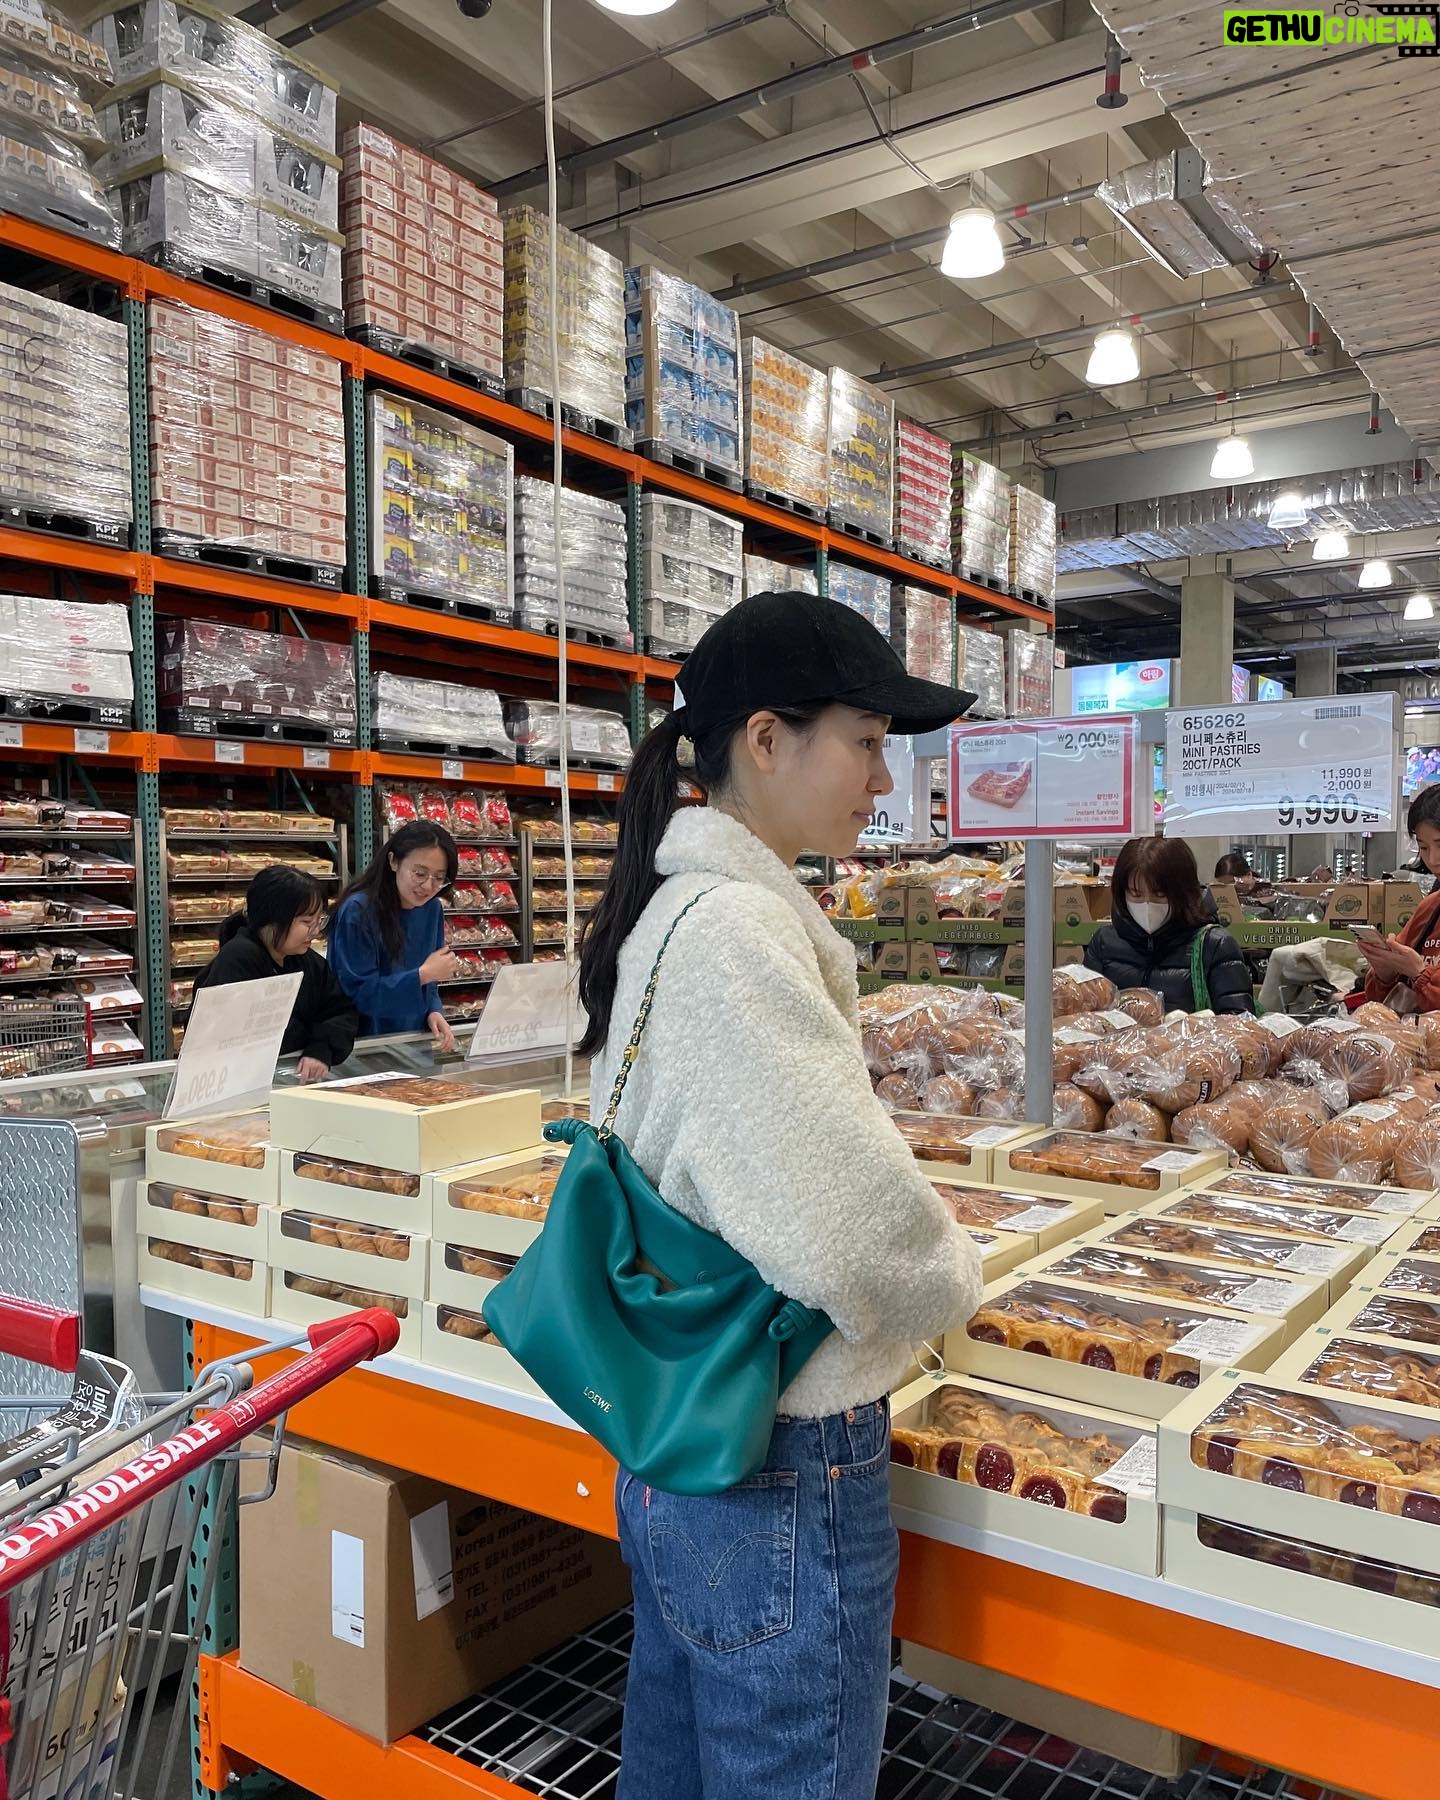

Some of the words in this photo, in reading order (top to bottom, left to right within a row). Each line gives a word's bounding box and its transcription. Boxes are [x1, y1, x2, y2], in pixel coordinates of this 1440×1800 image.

[317, 569, 335, 579] KPP
[495, 610, 509, 618] KPP
[100, 707, 123, 718] KPP
[1183, 713, 1246, 731] 656262
[333, 730, 351, 739] KPP
[1182, 730, 1247, 746] 미니페스츄리
[1182, 746, 1206, 758] MINI
[1210, 743, 1262, 757] PASTRIES
[1182, 757, 1242, 771] 20CT/PACK
[937, 931, 1001, 941] VEGETABLES
[1268, 926, 1299, 934] DRIED
[583, 1386, 613, 1413] LOEWE
[27, 1417, 222, 1541] WHOLESALE
[465, 1581, 489, 1601] TEL
